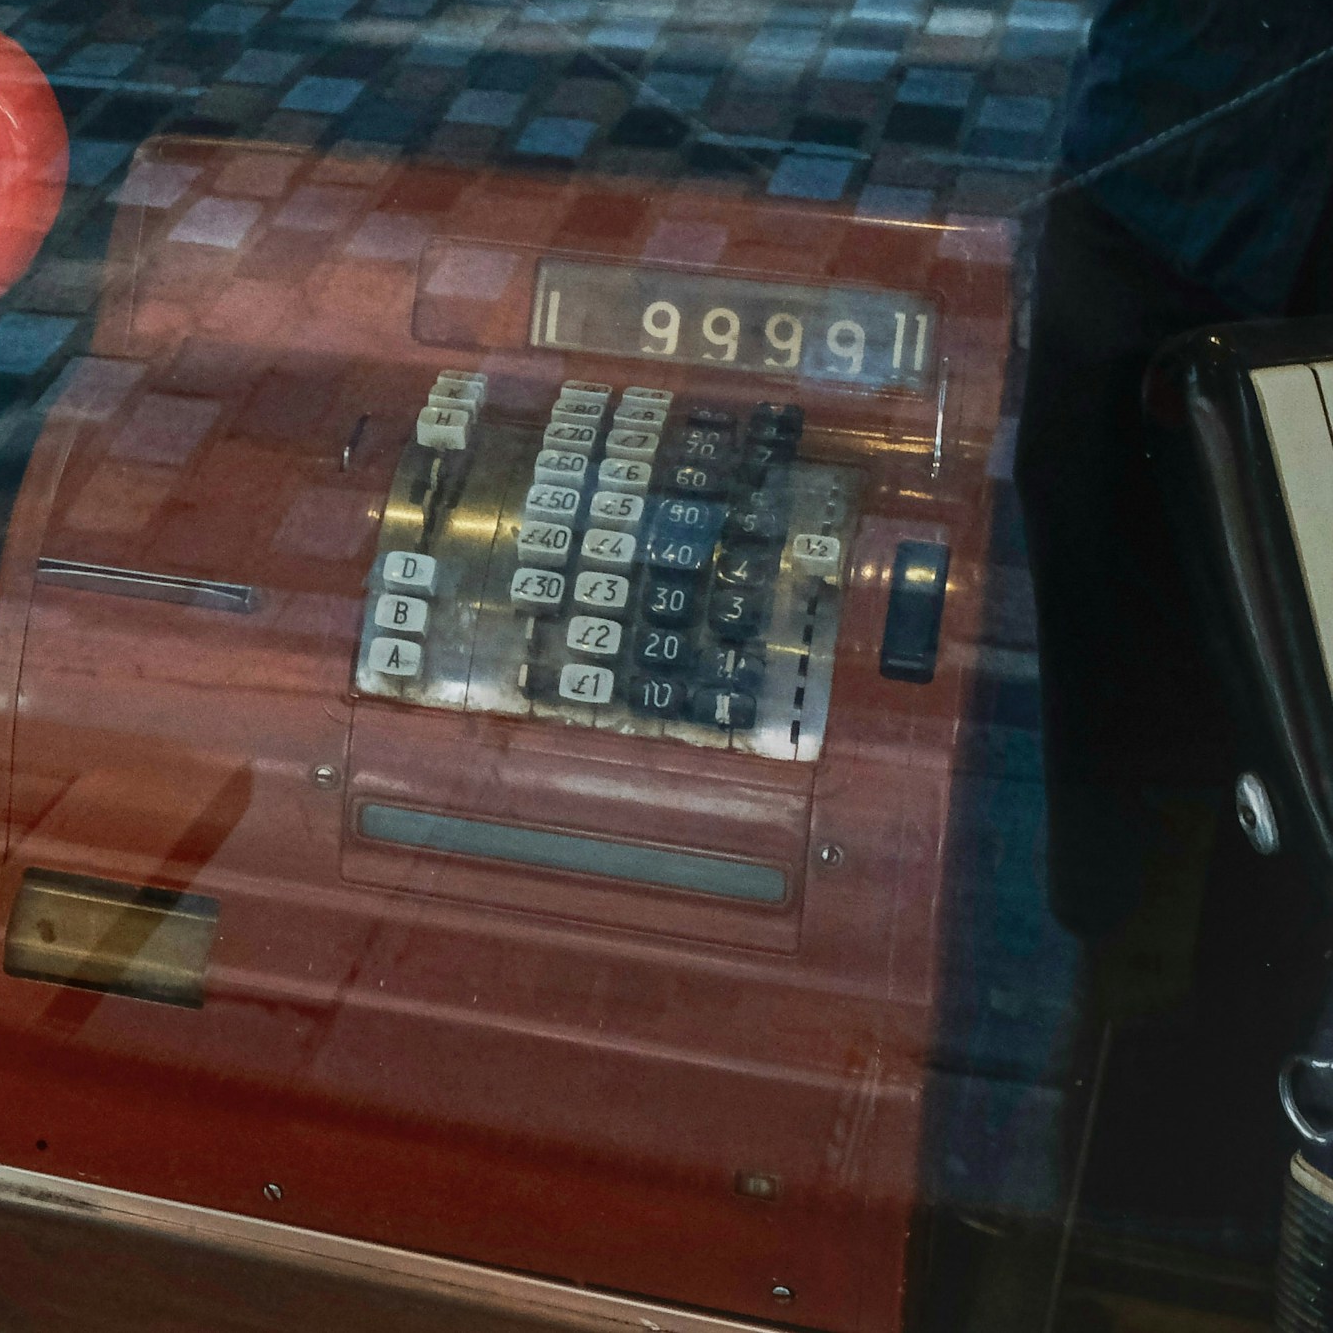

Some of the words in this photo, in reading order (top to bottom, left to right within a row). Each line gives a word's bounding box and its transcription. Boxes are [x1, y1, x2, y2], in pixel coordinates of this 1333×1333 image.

[435, 411, 452, 426] H
[547, 427, 593, 443] £70
[617, 435, 649, 449] £7
[538, 456, 584, 472] £60
[604, 465, 640, 481] £6
[676, 469, 707, 487] 60
[530, 491, 577, 510] £50
[598, 498, 634, 516] £5
[668, 504, 700, 525] 50
[742, 514, 757, 532] 5
[521, 528, 568, 549] £40
[590, 537, 624, 557] £4
[660, 543, 693, 565] 40
[401, 557, 418, 579] D
[514, 574, 562, 598] £30
[583, 579, 619, 602] £3
[651, 587, 685, 612] 30
[725, 596, 745, 619] 3
[393, 601, 409, 625] B
[575, 624, 611, 649] £2
[644, 632, 679, 660] 20
[386, 644, 400, 669] A
[570, 672, 601, 697] £1
